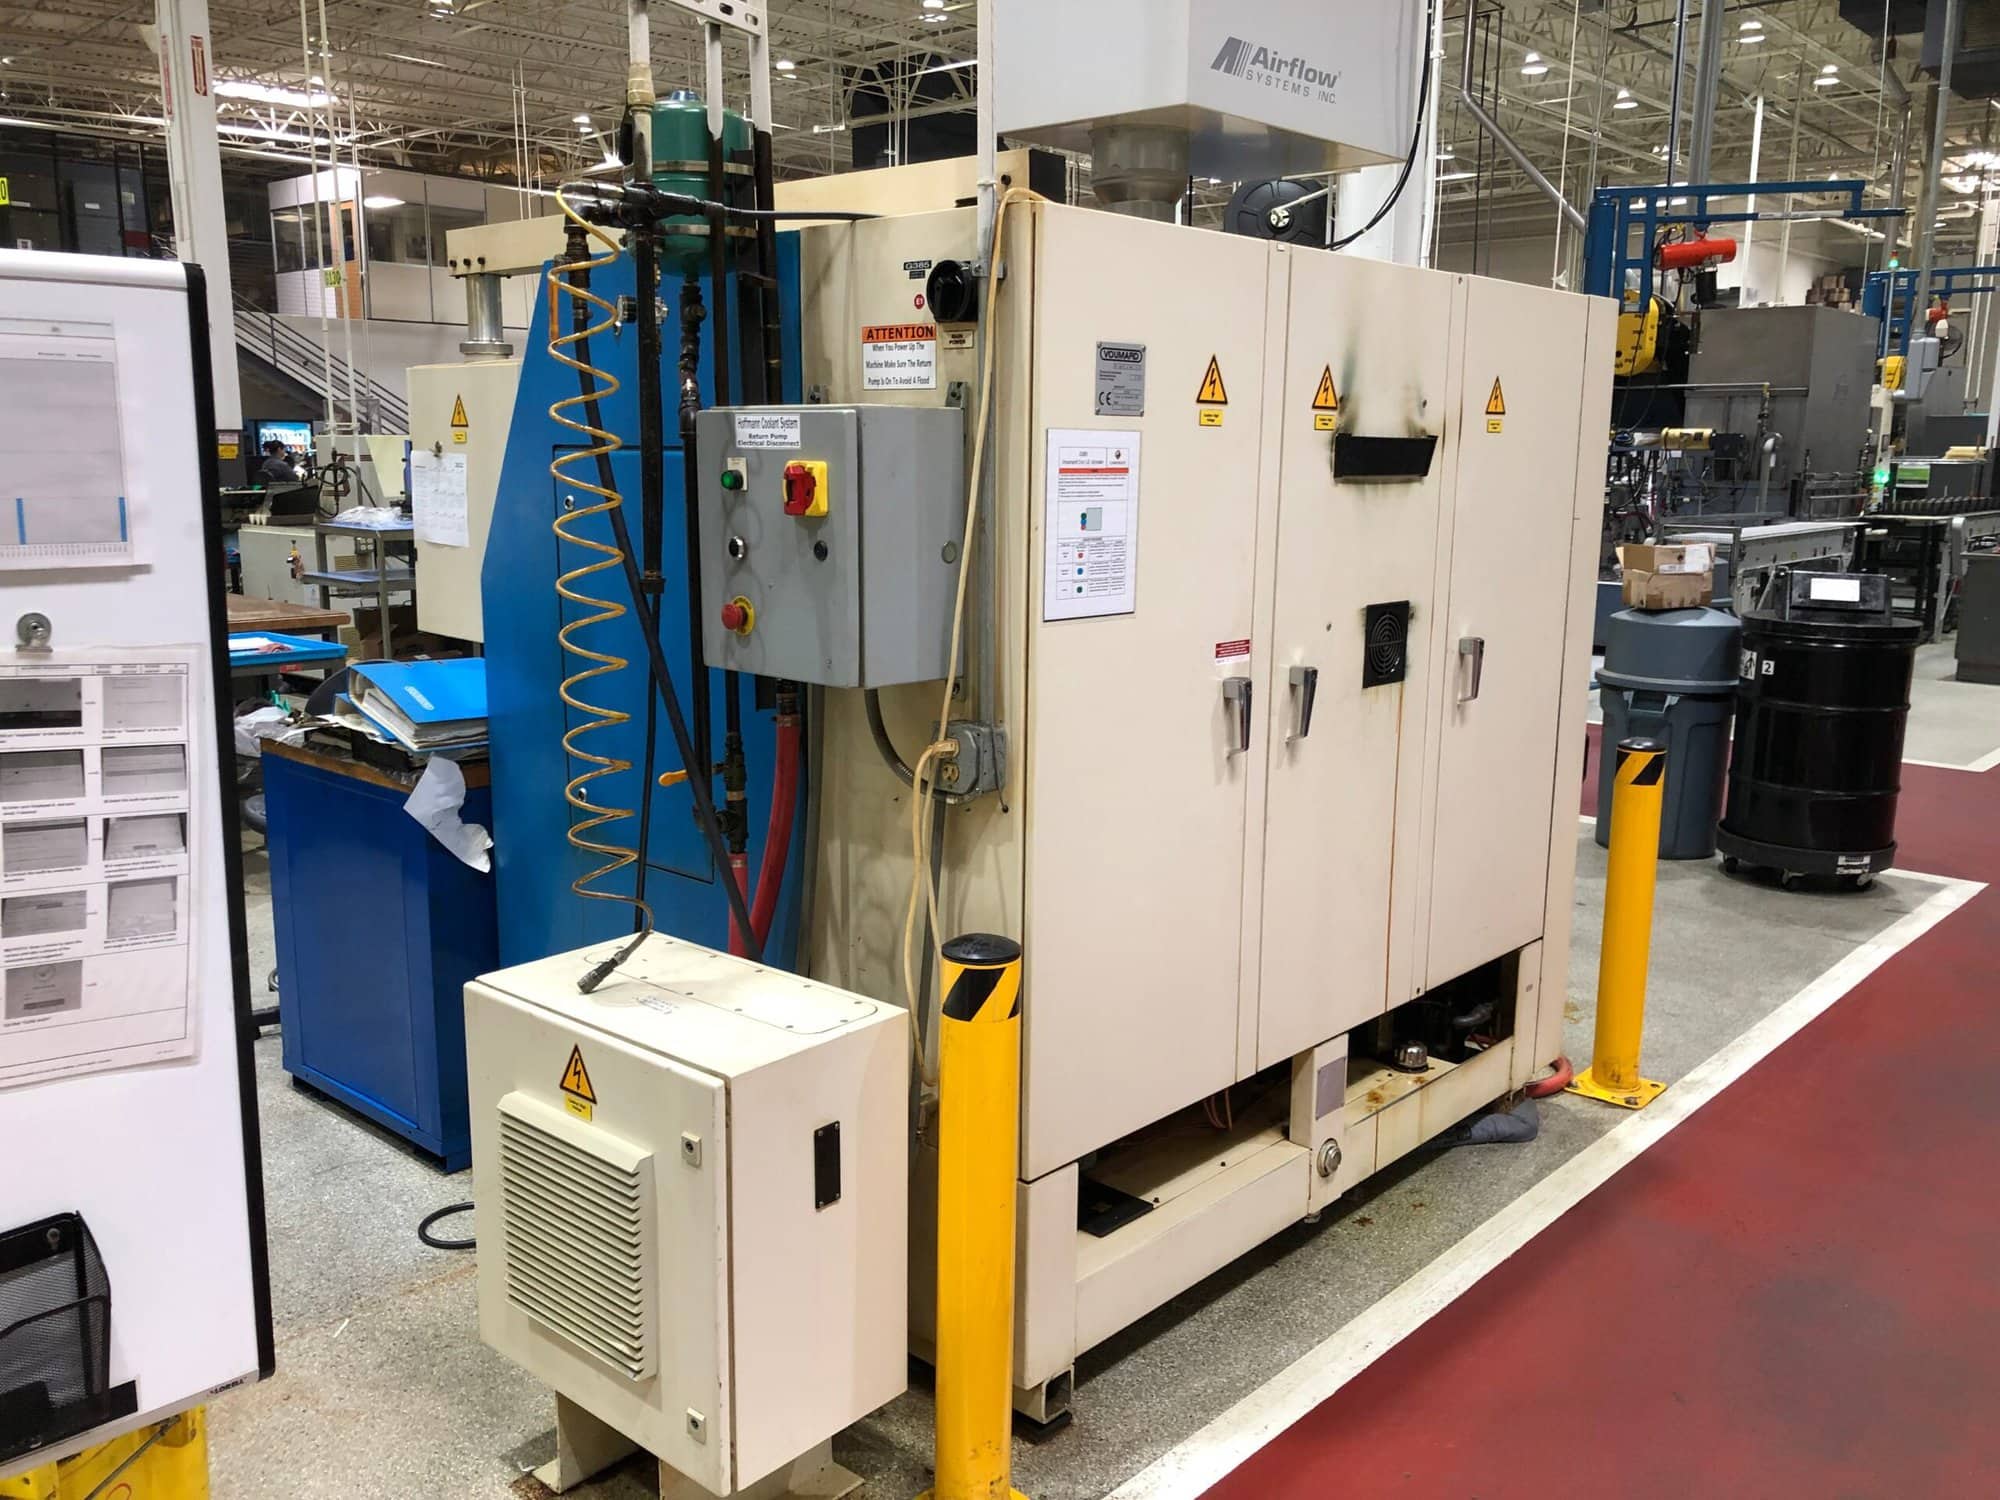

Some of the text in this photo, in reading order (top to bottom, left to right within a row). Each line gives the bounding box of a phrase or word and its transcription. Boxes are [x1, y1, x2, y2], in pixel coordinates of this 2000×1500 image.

[1249, 46, 1338, 89] Airflow
[1246, 69, 1337, 104] SYSTEMS INC.
[867, 326, 934, 340] ATTENTION
[872, 343, 884, 352] When
[895, 343, 907, 351] Power
[916, 342, 925, 350] The
[1103, 350, 1140, 360] VOUMARD
[866, 360, 883, 368] Machine
[897, 360, 907, 368] Sure
[908, 359, 916, 368] The
[917, 360, 932, 368] Return
[917, 376, 930, 385] Flood
[780, 416, 798, 431] System
[770, 433, 788, 441] Pump
[1764, 662, 1772, 673] 2
